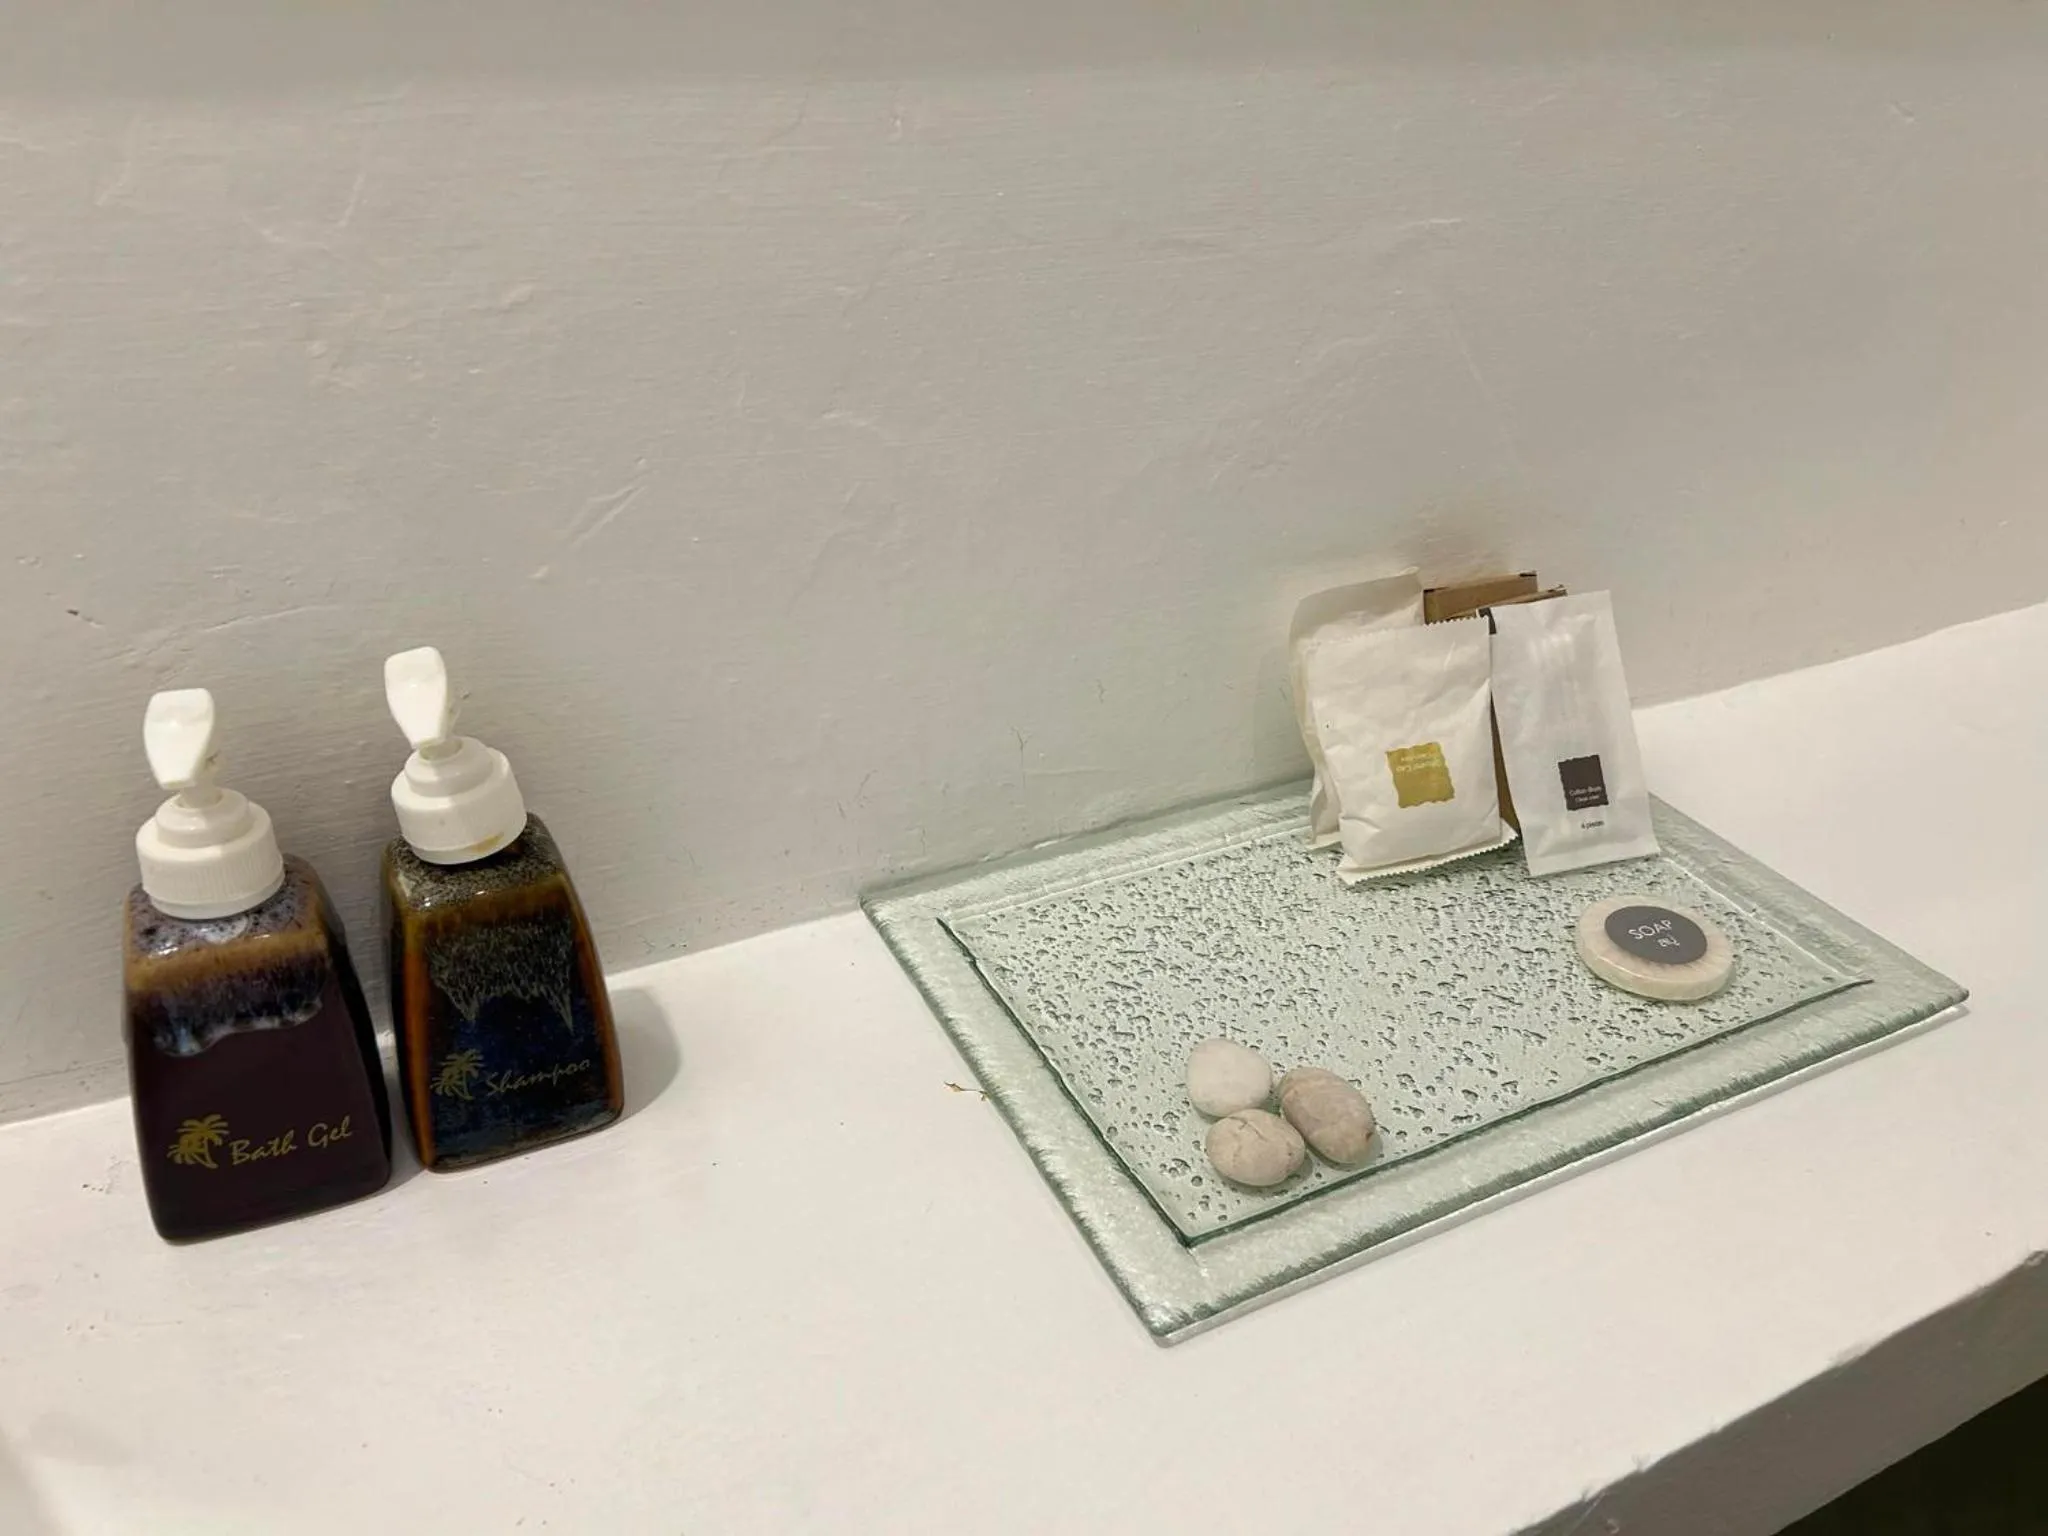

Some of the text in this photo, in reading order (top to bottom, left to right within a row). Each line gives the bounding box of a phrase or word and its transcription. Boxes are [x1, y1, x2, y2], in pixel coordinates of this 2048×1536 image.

[1628, 919, 1672, 940] SOAP
[485, 1058, 591, 1096] Shampoo
[229, 1115, 352, 1166] Bath Gel
